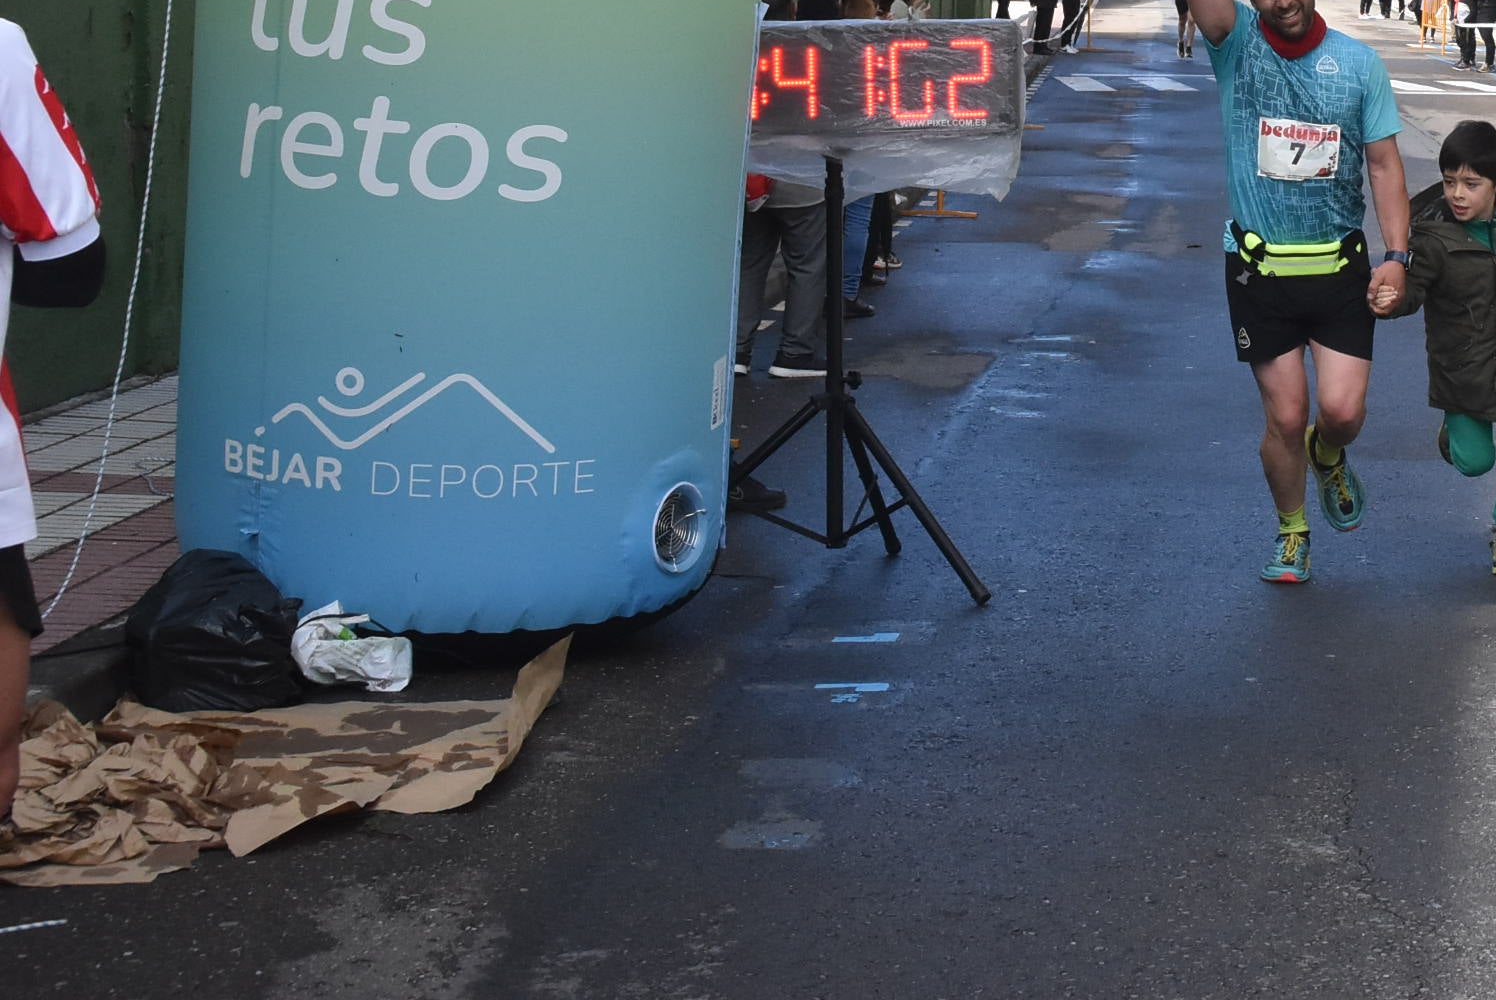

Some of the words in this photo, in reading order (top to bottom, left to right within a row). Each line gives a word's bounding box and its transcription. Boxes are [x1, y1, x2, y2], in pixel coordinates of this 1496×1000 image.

[240, 96, 568, 202] retos
[1290, 142, 1306, 165] 7
[224, 426, 341, 491] BÉJAR
[371, 459, 596, 498] DEPORTE
